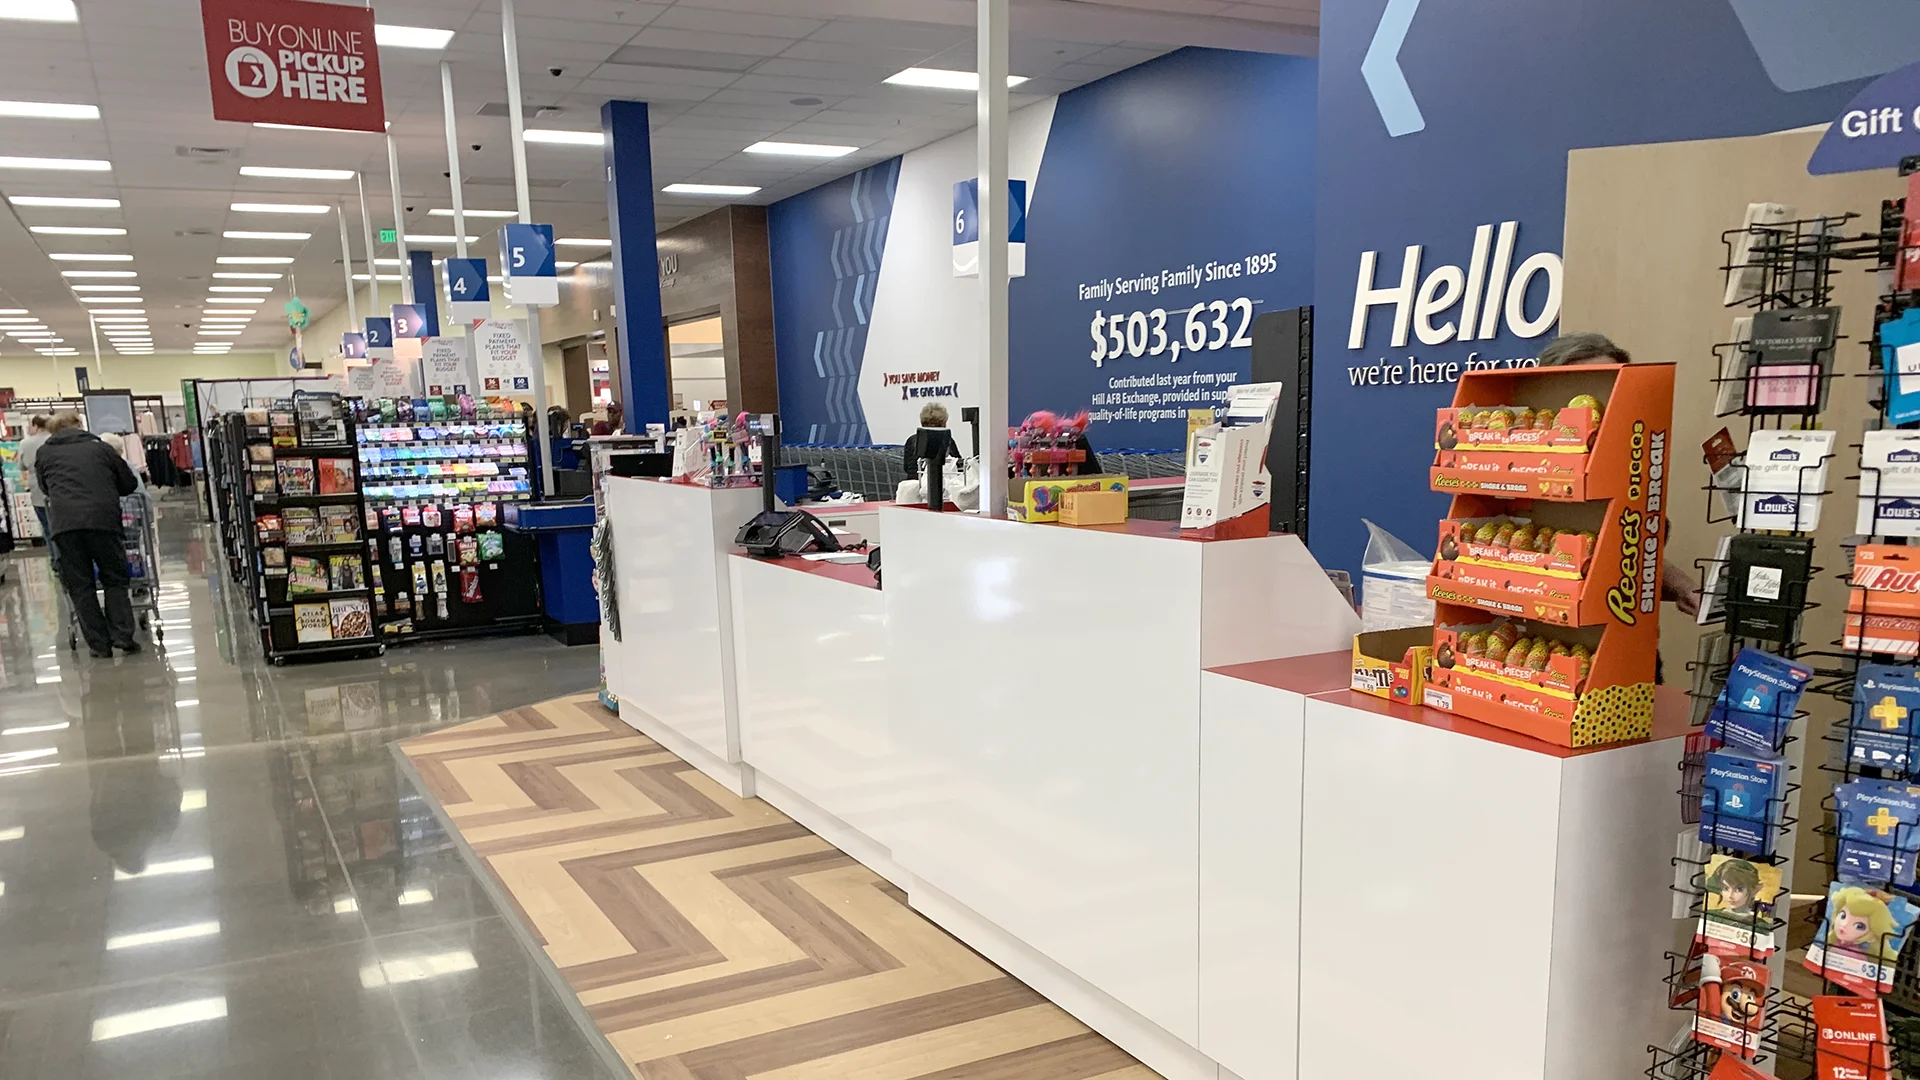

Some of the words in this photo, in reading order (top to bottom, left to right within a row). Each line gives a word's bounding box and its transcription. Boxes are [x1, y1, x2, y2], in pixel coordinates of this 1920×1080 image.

[228, 18, 276, 46] BUY
[277, 24, 364, 55] ONLINE
[278, 49, 365, 75] PICKUP
[280, 70, 367, 104] HERE
[1841, 106, 1903, 137] Gift
[955, 209, 964, 234] 6
[512, 247, 526, 268] 5
[660, 253, 679, 275] YOU
[453, 277, 467, 294] 4
[1079, 278, 1114, 302] Family
[1115, 273, 1160, 295] Serving
[1161, 264, 1203, 289] Family
[1205, 260, 1242, 282] Since
[1244, 252, 1277, 275] 1895
[1347, 220, 1563, 350] Hello
[397, 318, 408, 333] 3
[1090, 297, 1253, 368] $503,632
[369, 330, 379, 343] 2
[1795, 335, 1823, 344] SECRET
[346, 343, 354, 356] 1
[1347, 357, 1401, 386] we're
[1408, 356, 1458, 384] here
[1465, 352, 1500, 372] for
[1505, 357, 1541, 370] yo
[888, 373, 901, 385] YOU
[901, 372, 917, 384] SAVE
[917, 371, 940, 383] MONEY
[1108, 374, 1156, 389] Contributed
[1156, 373, 1171, 386] last
[1172, 375, 1192, 388] year
[1193, 371, 1215, 385] from
[1215, 372, 1237, 386] your
[909, 387, 919, 398] WE
[920, 386, 935, 397] GIVE
[935, 385, 952, 397] BACK
[1092, 392, 1105, 405] Hill
[1106, 393, 1121, 404] AFB
[1122, 391, 1161, 407] Exchange,
[1162, 388, 1200, 406] provided
[1201, 389, 1210, 401] in
[1211, 389, 1228, 404] sup
[1087, 408, 1137, 424] quality-of-life
[1138, 409, 1176, 422] programs
[1177, 407, 1186, 418] in
[1468, 432, 1494, 442] BREAK
[1494, 432, 1501, 440] it
[1501, 436, 1510, 444] to
[1510, 431, 1540, 442] PIECES!
[1772, 452, 1798, 460] LOWE'S
[1890, 454, 1918, 462] LOWE'S
[1764, 464, 1779, 473] gift
[1781, 464, 1791, 472] of
[1883, 466, 1898, 475] gift
[1902, 466, 1911, 474] of
[1435, 473, 1460, 488] Reese's
[1758, 502, 1795, 513] LOWE'S
[1880, 506, 1920, 518] LOWE'S
[1646, 514, 1660, 534] &
[1469, 546, 1494, 558] BREAK
[1494, 549, 1501, 558] it
[1500, 554, 1509, 562] to
[1508, 552, 1538, 564] PIECES!
[1607, 507, 1642, 625] Reese's
[1431, 584, 1457, 601] Reese's
[332, 603, 369, 614] BRUNCH
[1465, 657, 1490, 670] BREAK
[1490, 661, 1497, 671] it
[1496, 668, 1504, 676] to
[1504, 667, 1532, 680] PIECES!
[1738, 664, 1778, 685] PlayStation
[1778, 679, 1797, 692] Store
[1362, 683, 1374, 692] 1.59
[1436, 699, 1450, 709] 1.79
[1710, 767, 1749, 782] PlayStation
[1750, 775, 1768, 784] Store
[1856, 793, 1900, 807] PlayStation
[1901, 800, 1917, 810] Plus
[1735, 930, 1758, 945] $50
[1861, 963, 1888, 981] $35
[1730, 1028, 1753, 1045] $20
[1834, 1030, 1877, 1041] ONLINE
[1832, 1066, 1846, 1079] 12
